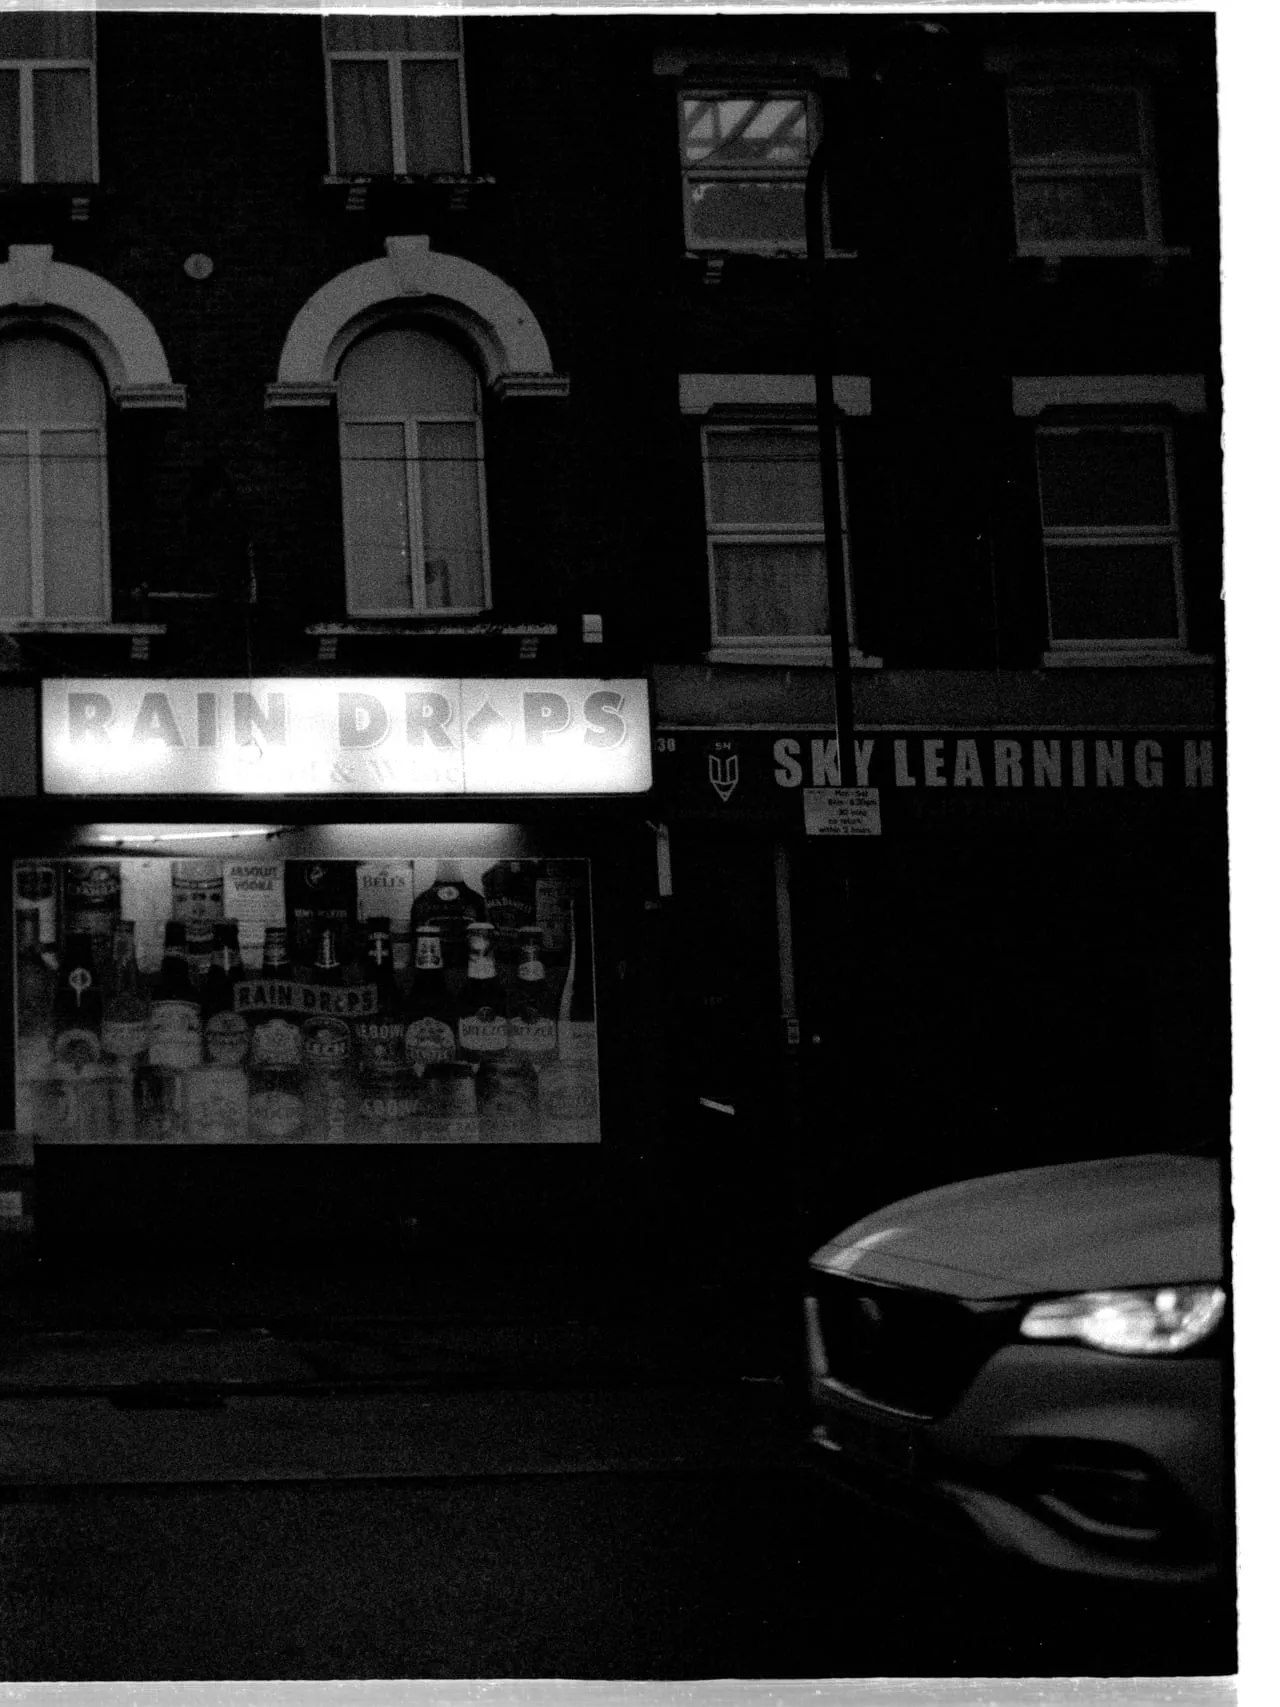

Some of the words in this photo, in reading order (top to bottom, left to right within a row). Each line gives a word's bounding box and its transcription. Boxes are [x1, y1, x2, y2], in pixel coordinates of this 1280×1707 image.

[67, 691, 287, 749] RAIN
[773, 738, 878, 788] SKY
[893, 738, 1165, 788] LEARNING
[237, 984, 296, 1012] RAIN
